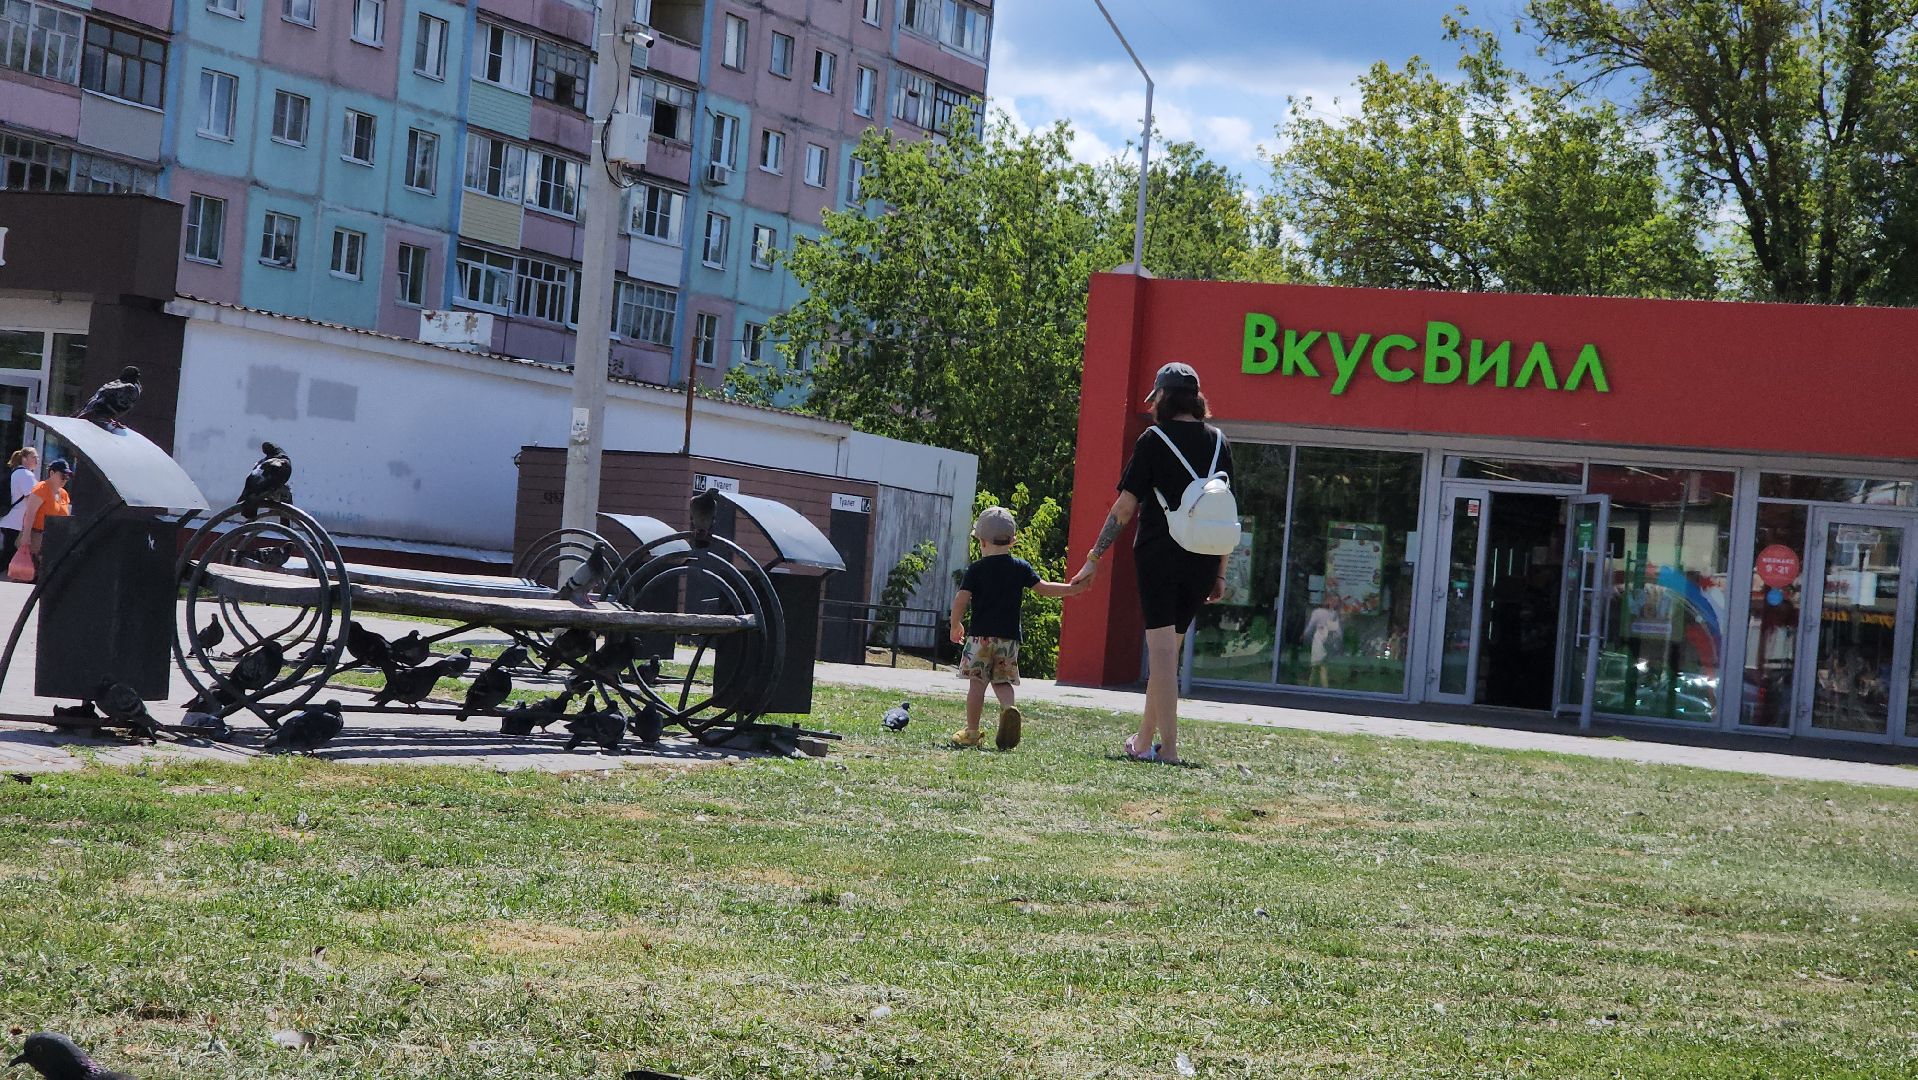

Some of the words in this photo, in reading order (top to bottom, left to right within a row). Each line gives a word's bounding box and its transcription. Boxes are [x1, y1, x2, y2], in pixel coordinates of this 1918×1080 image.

[1241, 312, 1609, 395] ВкусВилл
[713, 479, 732, 491] Туалет
[839, 496, 856, 508] Туалет
